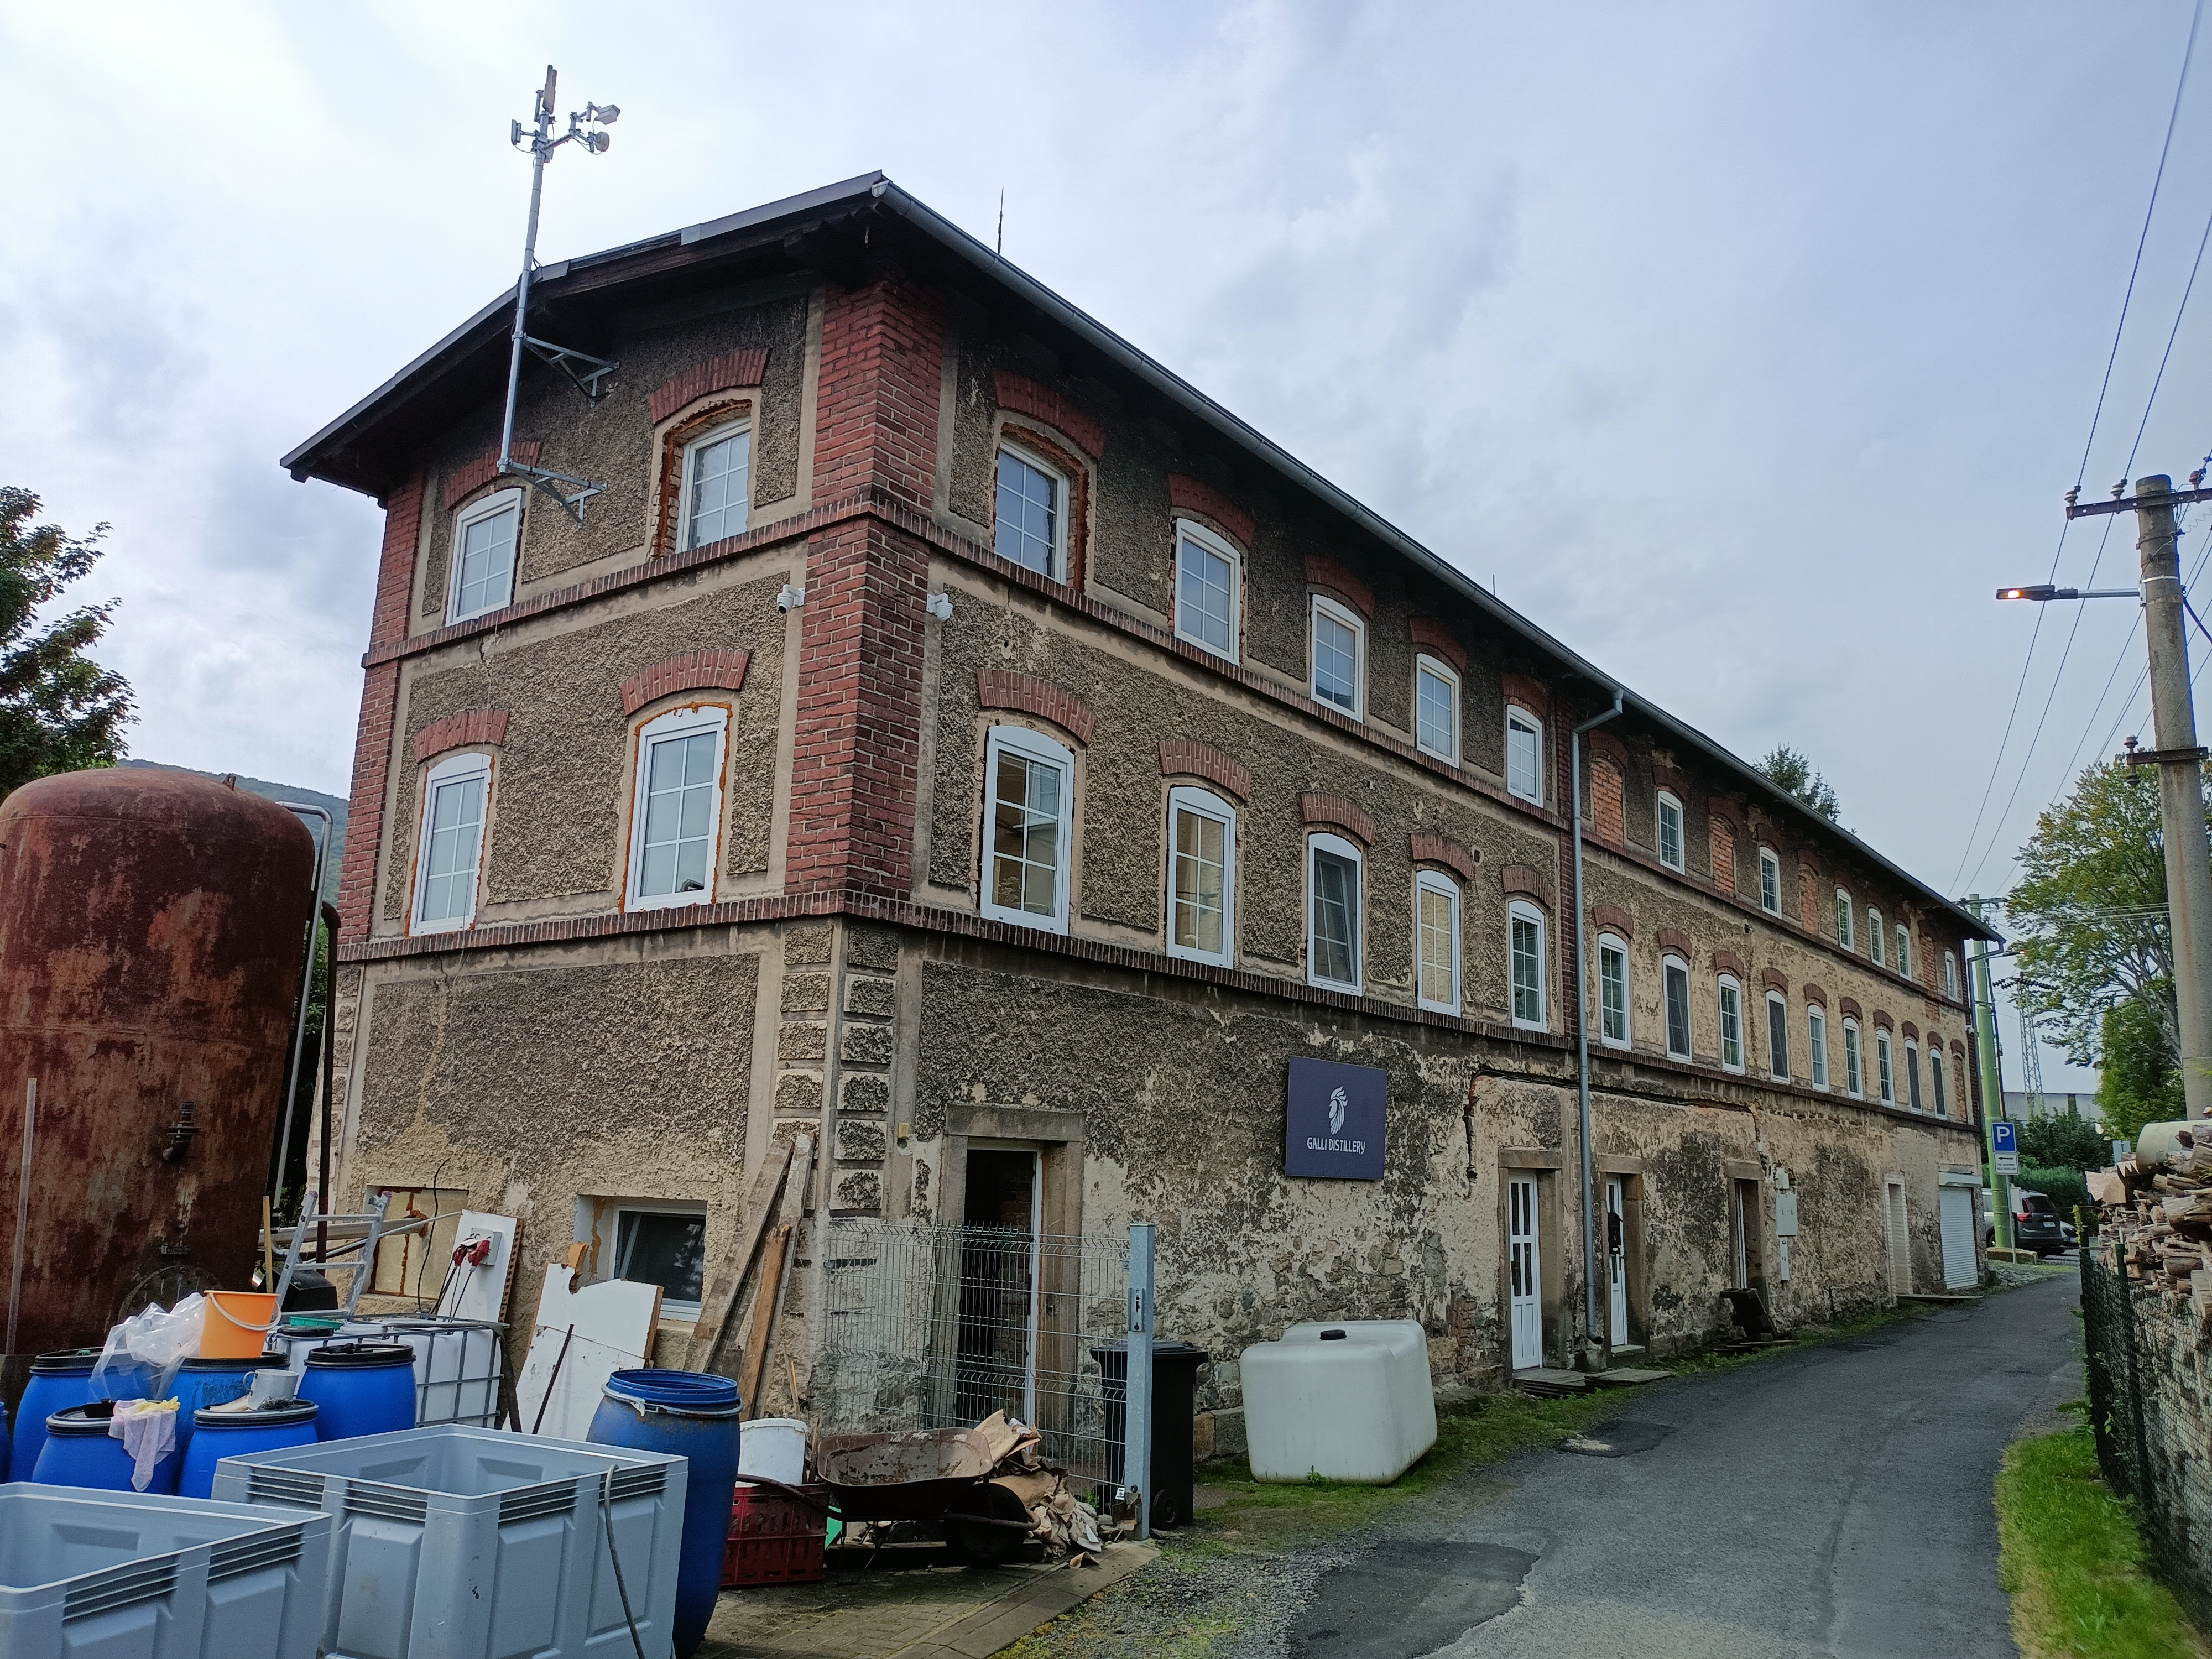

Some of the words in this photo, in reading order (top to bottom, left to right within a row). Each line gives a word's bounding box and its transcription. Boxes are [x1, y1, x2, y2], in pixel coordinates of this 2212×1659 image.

[1996, 1126, 2010, 1143] P
[1307, 1137, 1327, 1150] GALLI
[1328, 1139, 1365, 1155] DISTILLERY
